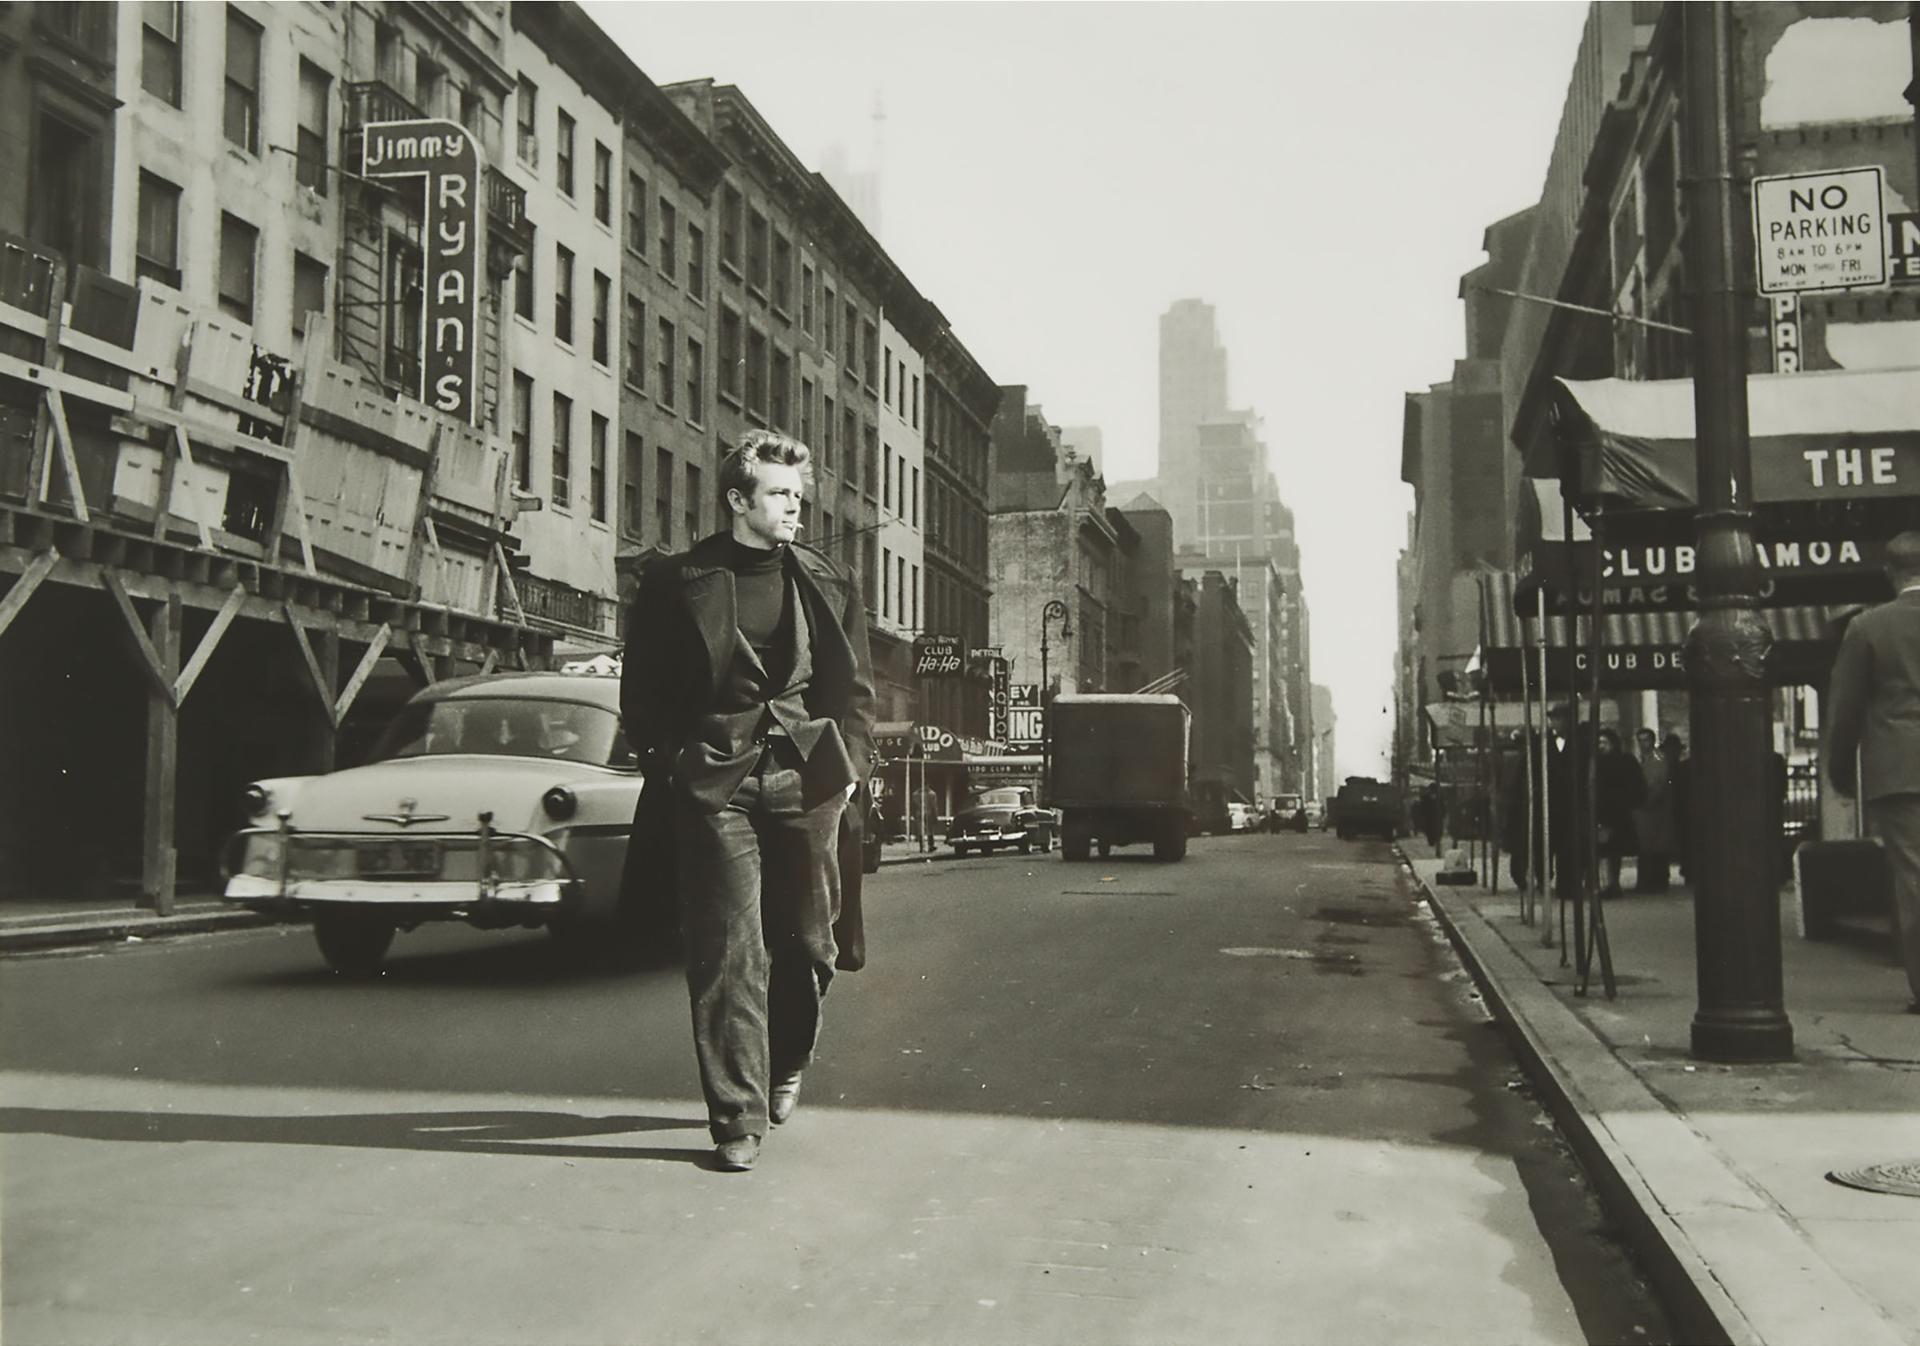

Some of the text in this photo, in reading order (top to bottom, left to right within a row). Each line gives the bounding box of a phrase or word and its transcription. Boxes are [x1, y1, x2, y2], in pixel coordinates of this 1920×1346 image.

[367, 135, 464, 166] Jimmy
[1790, 185, 1848, 213] NO
[1771, 212, 1871, 242] PARKING
[1777, 247, 1785, 260] 8
[1811, 243, 1826, 257] TO
[1835, 243, 1843, 255] 6
[1780, 263, 1806, 277] MON
[1841, 259, 1862, 272] FRI
[1804, 448, 1896, 487] THE
[924, 645, 953, 656] CLUB
[1576, 653, 1637, 669] CUB
